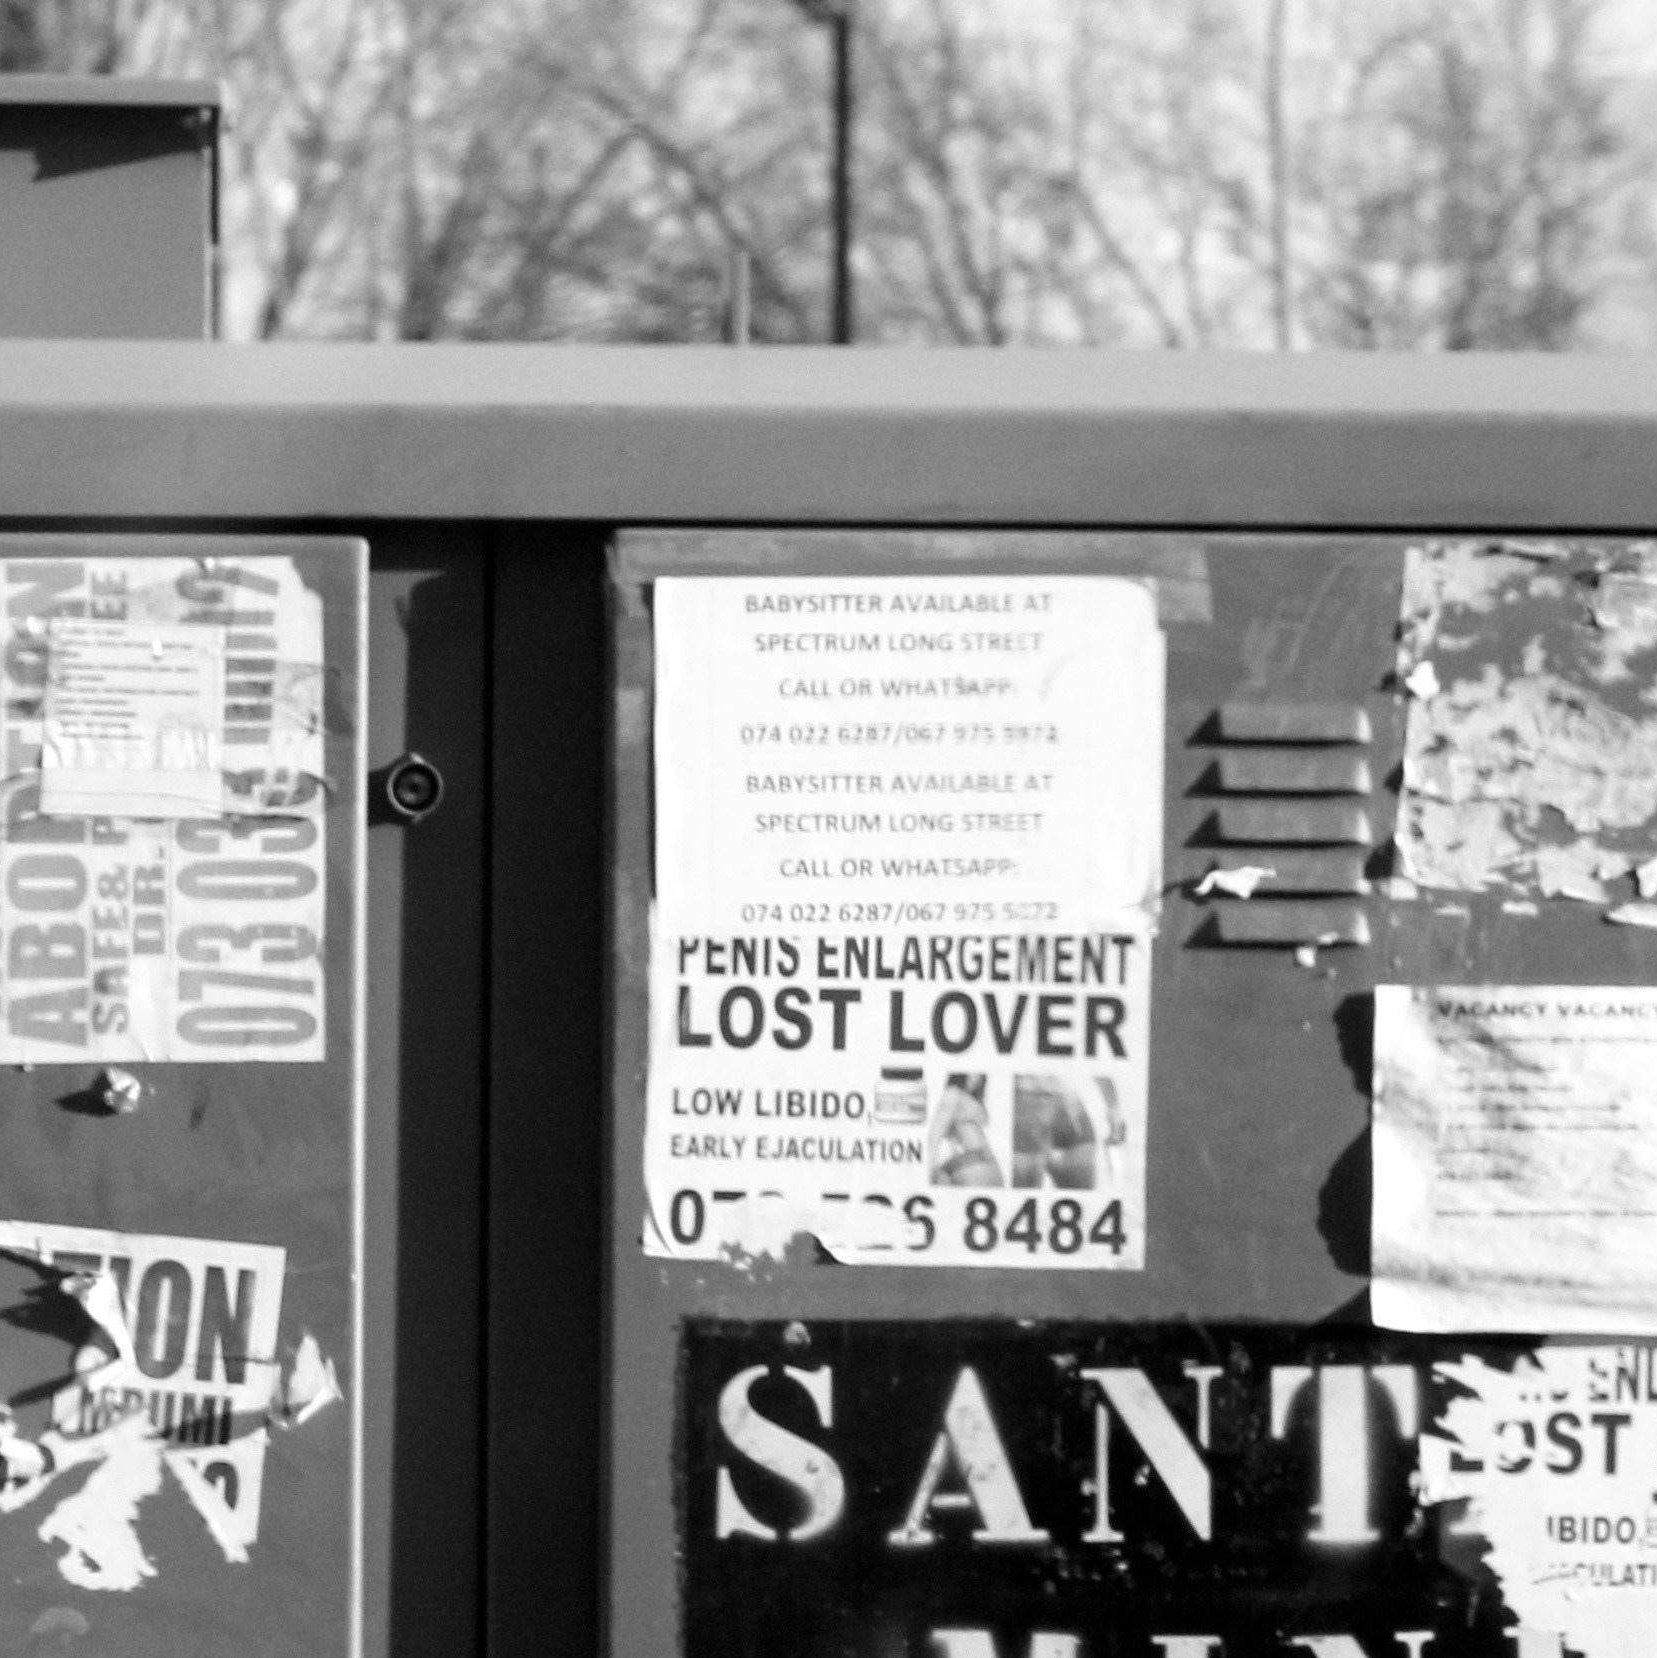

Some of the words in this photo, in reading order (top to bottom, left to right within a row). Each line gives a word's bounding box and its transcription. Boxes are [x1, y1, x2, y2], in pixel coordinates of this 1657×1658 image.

[744, 593, 883, 615] BABYSITTER
[889, 593, 1014, 615] AVAILABLE
[1023, 593, 1053, 615] AT
[754, 631, 880, 654] SPECTRUM
[887, 631, 953, 654] LONG
[961, 631, 1045, 654] STREET
[779, 677, 832, 699] CALL
[839, 677, 872, 699] OR
[745, 774, 884, 796] BABYSITTER
[890, 774, 1015, 796] AVAILABLE
[1023, 774, 1055, 796] AT
[754, 813, 882, 835] SPECTRUM
[888, 813, 955, 835] LONG
[961, 813, 1045, 835] STREET
[779, 858, 833, 880] CALL
[840, 858, 874, 880] OR
[741, 902, 783, 925] 074
[790, 902, 832, 925] 022
[838, 901, 946, 928] 6287/067
[92, 864, 130, 1037] SAFE&
[816, 933, 1134, 986] ENLARGEMENT
[175, 923, 318, 1047] 073
[676, 984, 863, 1051] LOST
[889, 989, 1129, 1059] LOVER
[671, 1087, 744, 1117] LOW
[670, 1134, 746, 1160] EARLY
[755, 1134, 924, 1165] EJACULATION
[963, 1196, 1129, 1257] 8484
[713, 1363, 1442, 1545] SANT
